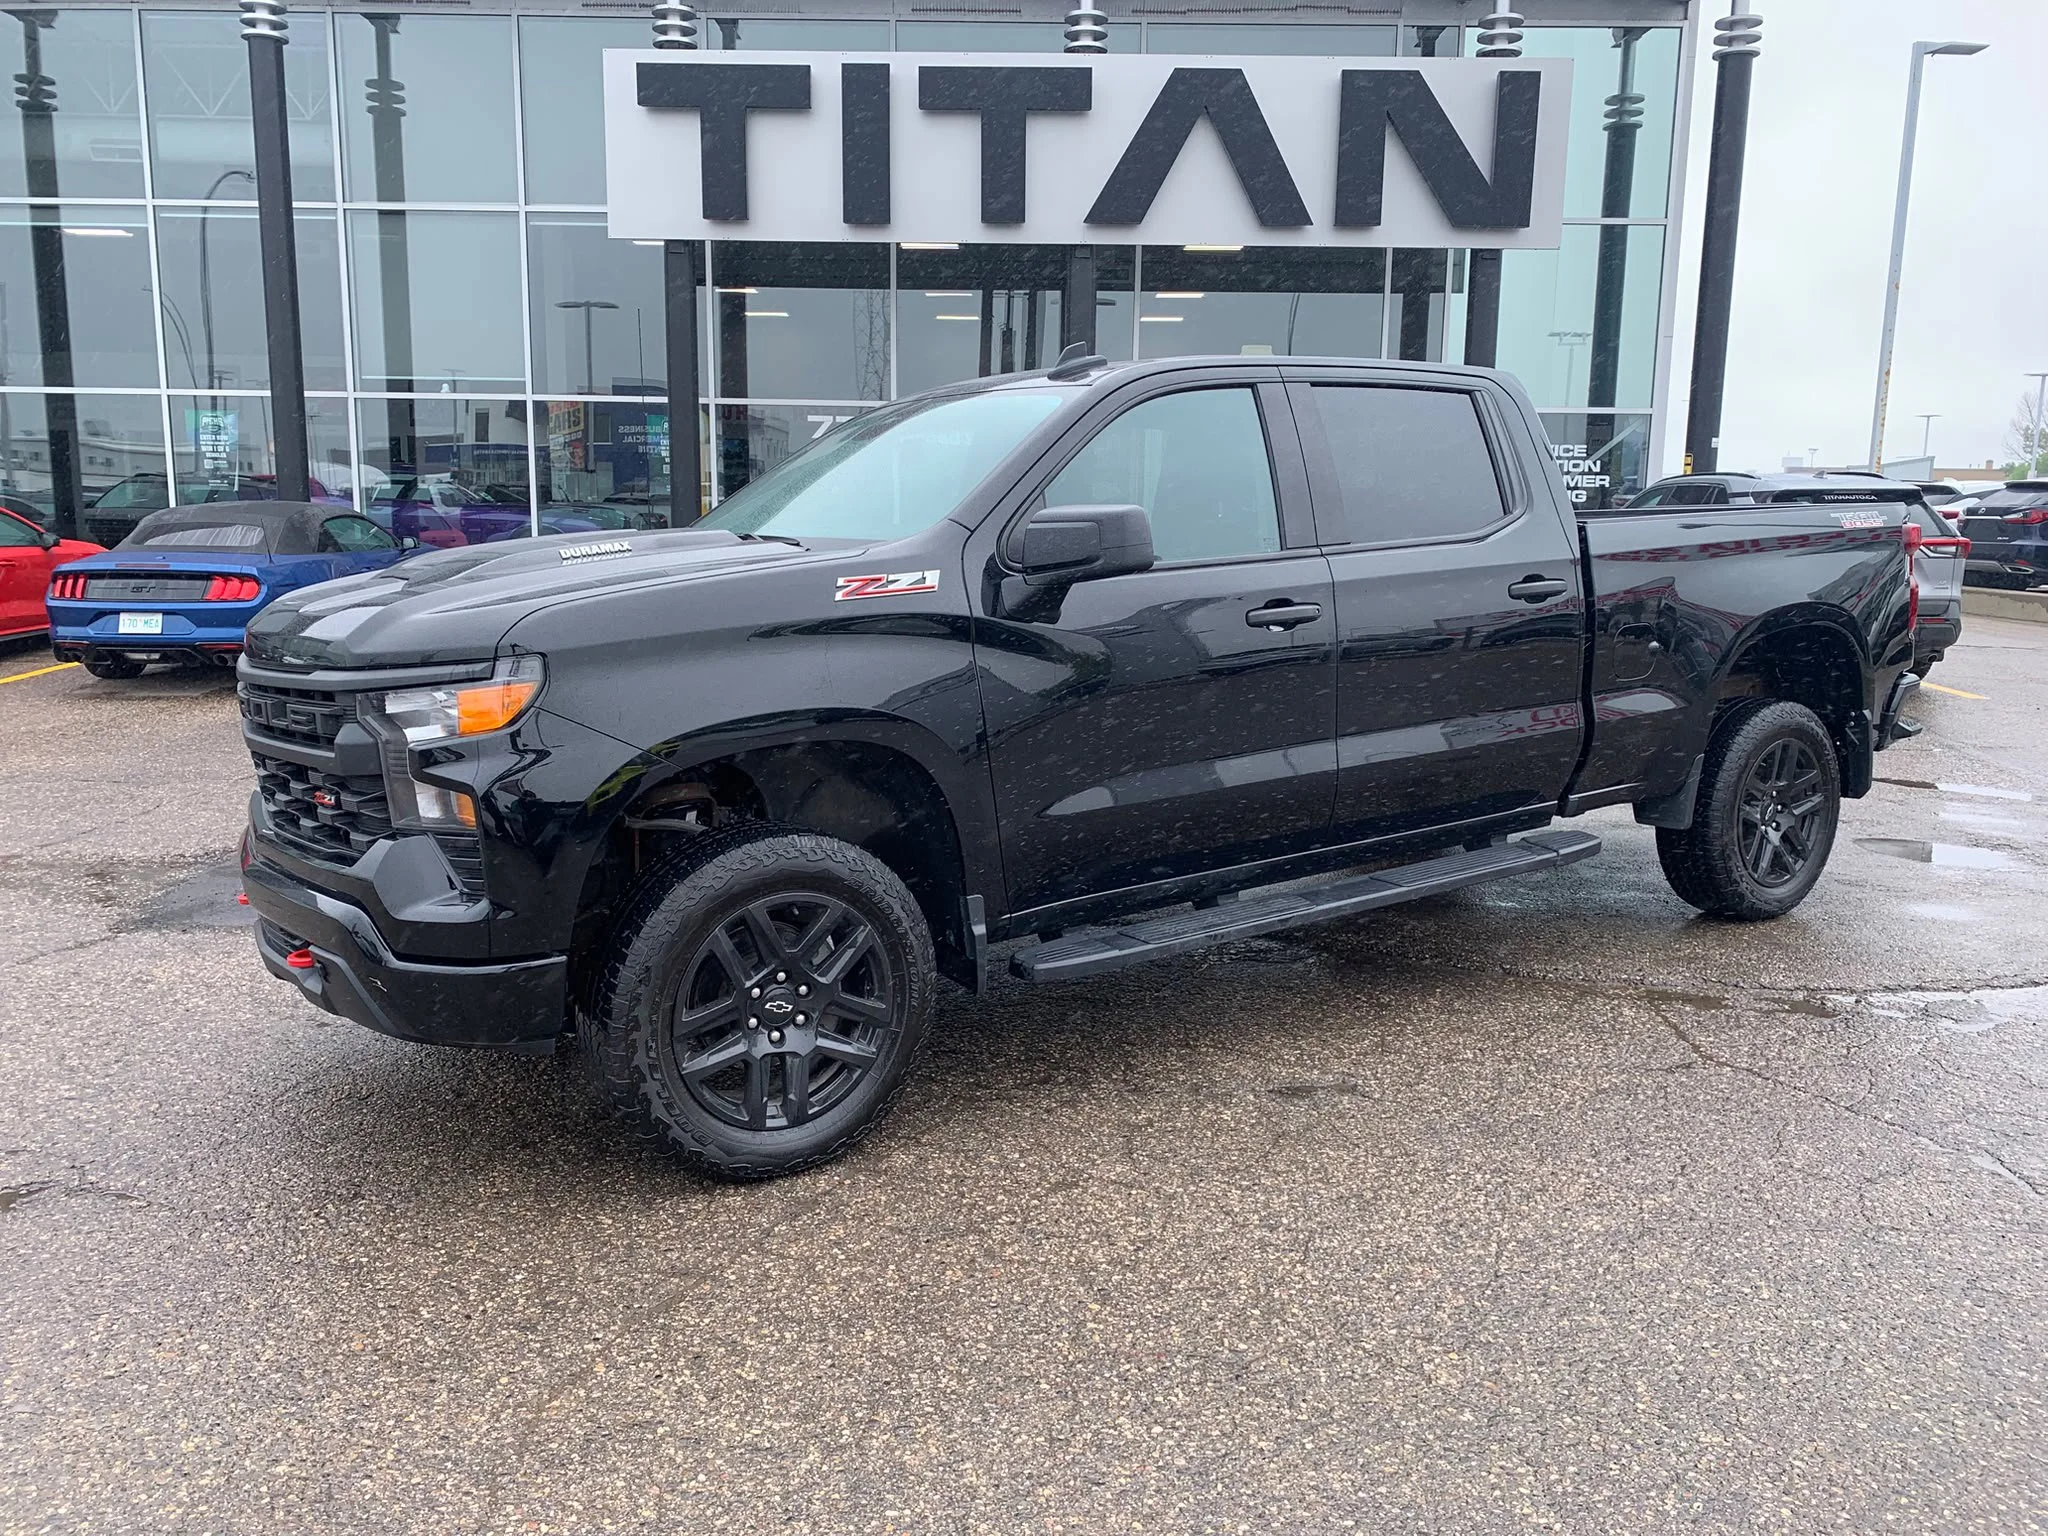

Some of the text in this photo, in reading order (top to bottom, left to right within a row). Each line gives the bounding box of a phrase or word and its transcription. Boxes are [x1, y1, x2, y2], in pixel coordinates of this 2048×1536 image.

[637, 62, 1542, 229] TITAN
[807, 415, 855, 438] 7
[1551, 444, 1587, 457] ICE
[1830, 511, 1888, 522] TRAIL
[1841, 520, 1884, 529] BOSS
[559, 541, 632, 560] DURAMAX
[834, 569, 941, 602] Z71
